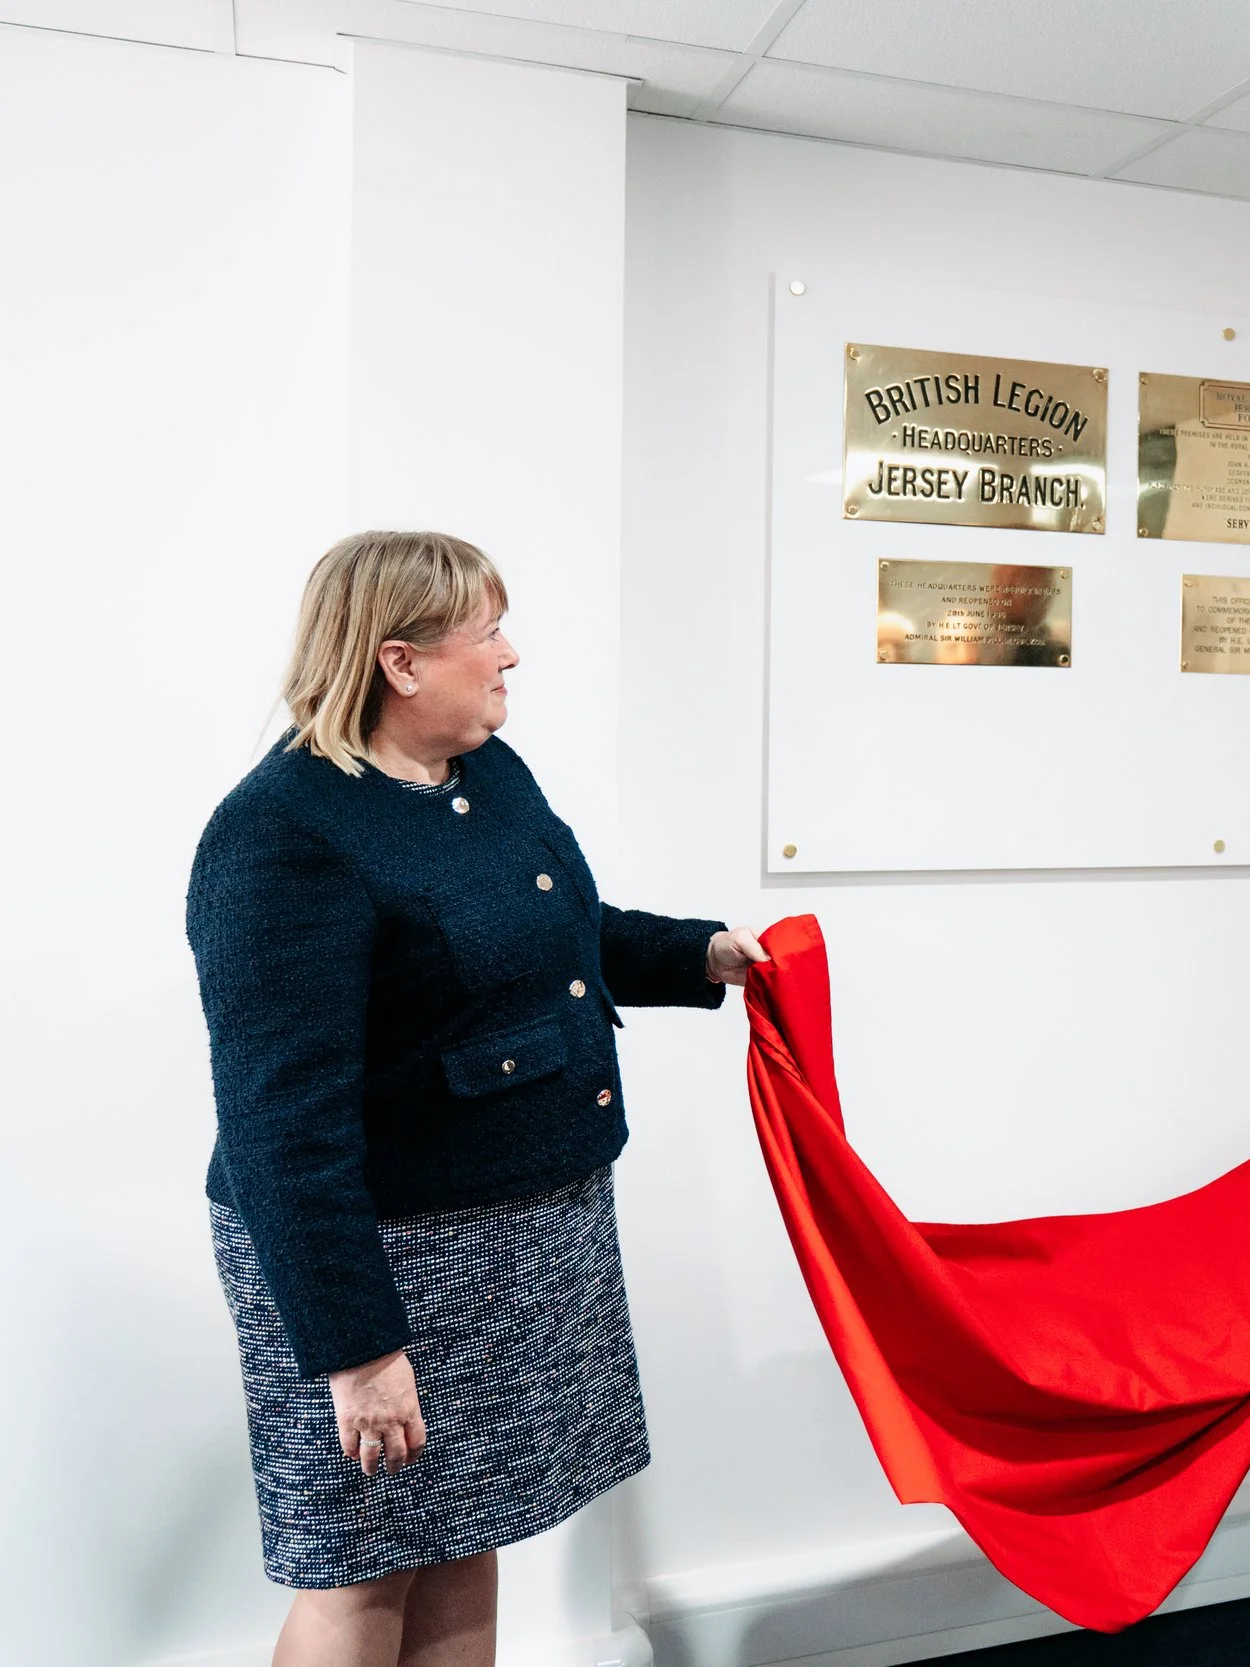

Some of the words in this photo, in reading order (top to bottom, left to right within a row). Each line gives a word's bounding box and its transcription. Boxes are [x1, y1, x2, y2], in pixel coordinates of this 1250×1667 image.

[1216, 392, 1246, 402] ROYAL
[865, 374, 980, 425] BRITISH
[993, 373, 1089, 443] LEGION
[902, 424, 1053, 458] HEADQUARTERS
[868, 461, 968, 500] JERSEY
[979, 468, 1086, 510] BRANCH.
[917, 581, 977, 592] HEADQUARTERS
[941, 596, 957, 604] AND
[1212, 596, 1228, 605] THIS
[966, 610, 986, 618] JUNE
[1193, 624, 1208, 633] AND
[1210, 625, 1247, 635] REOPENED
[904, 633, 938, 642] ADMIRAL
[954, 635, 984, 643] WILLIAM
[1218, 636, 1228, 644] BY
[1194, 645, 1227, 655] GENERAL
[1229, 646, 1241, 655] SIR
